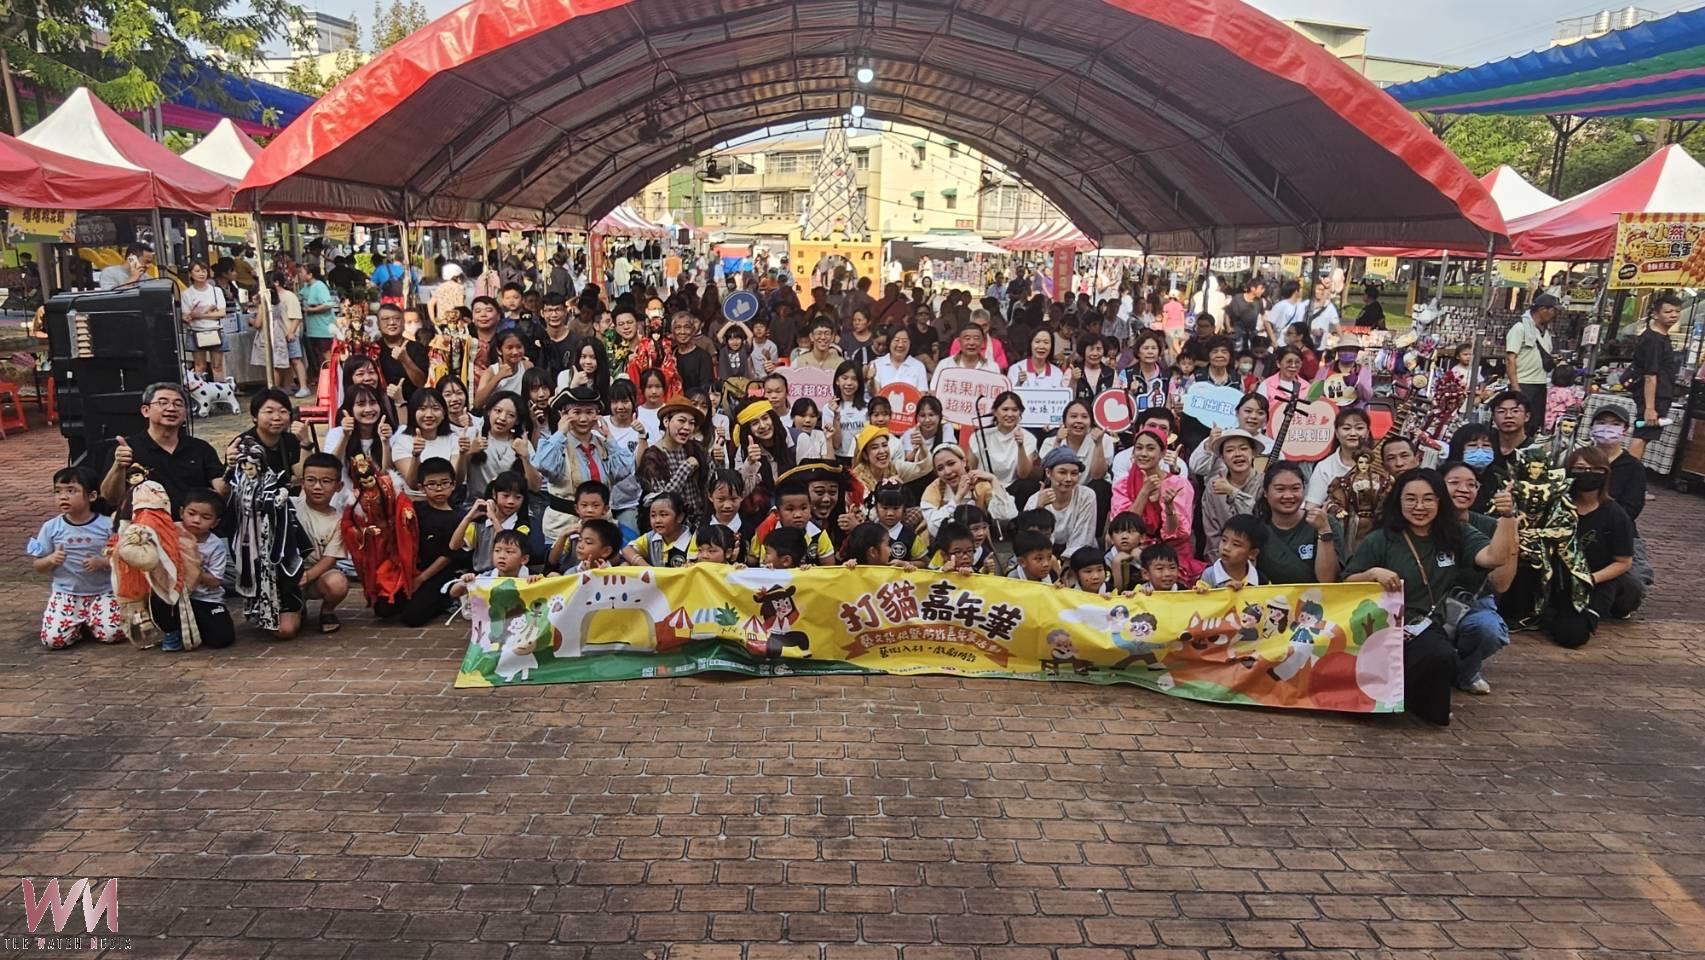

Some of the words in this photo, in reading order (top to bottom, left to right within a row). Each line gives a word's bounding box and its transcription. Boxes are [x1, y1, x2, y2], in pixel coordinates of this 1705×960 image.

[790, 383, 834, 398] 演超好
[943, 378, 1004, 399] 蘋果劇團
[1286, 428, 1330, 443] 果劇團
[839, 579, 1022, 641] 打貓嘉年華
